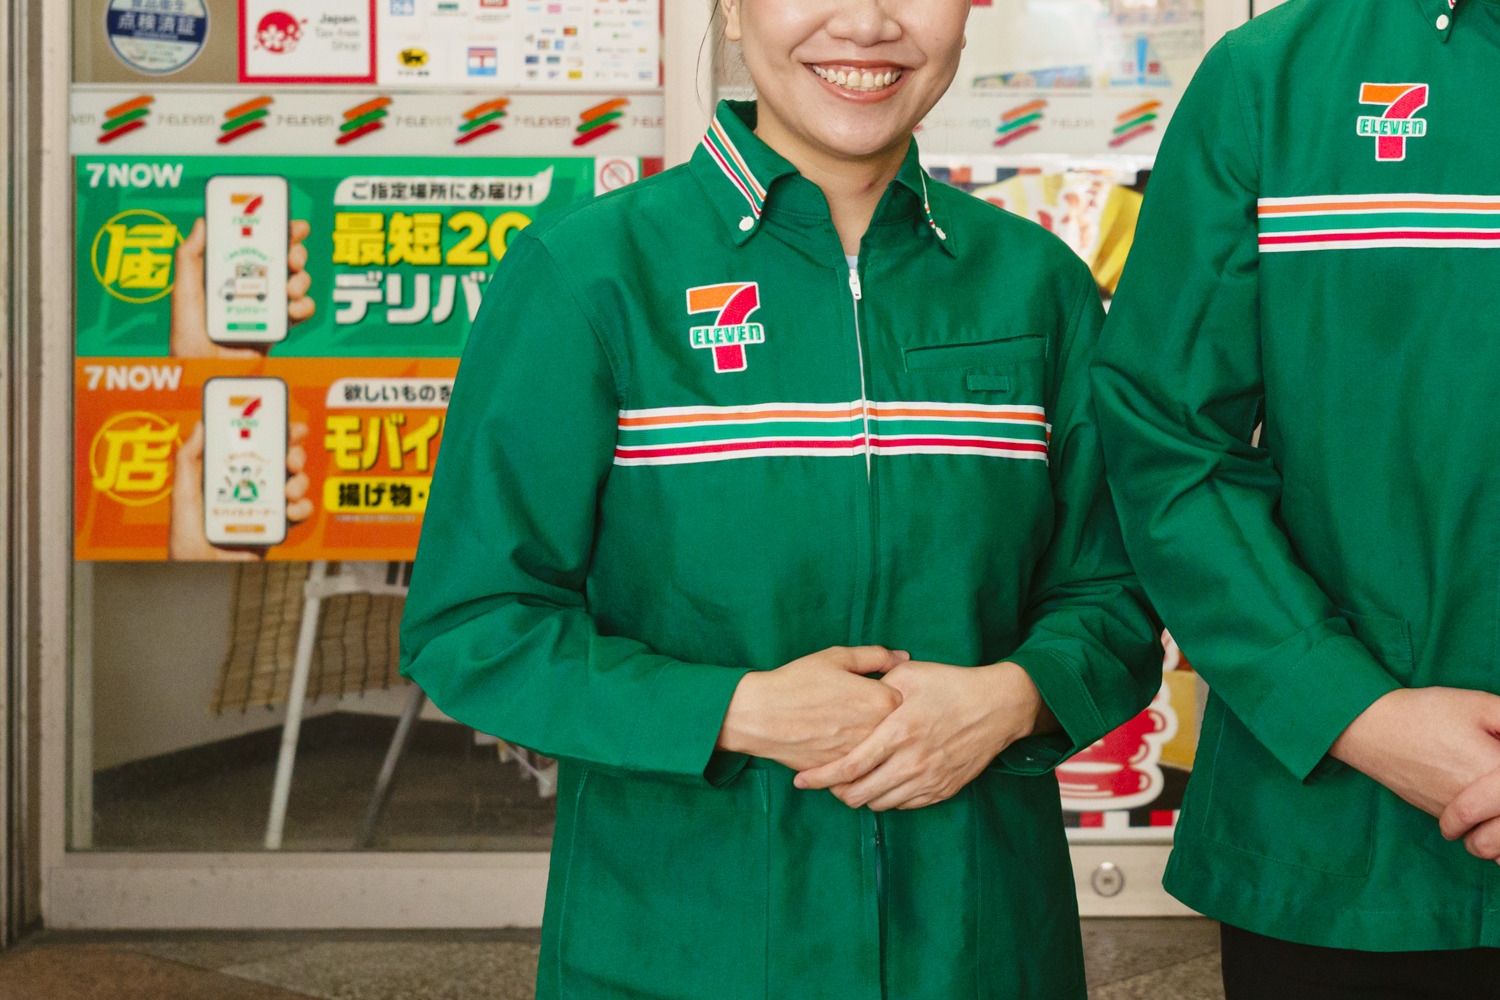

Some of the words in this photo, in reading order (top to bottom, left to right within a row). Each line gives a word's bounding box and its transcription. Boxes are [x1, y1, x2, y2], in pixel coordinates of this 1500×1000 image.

[1360, 84, 1427, 159] 7
[332, 270, 494, 325] デリバ
[688, 283, 760, 371] 7
[93, 422, 180, 492] 店
[324, 412, 447, 472] モバイ
